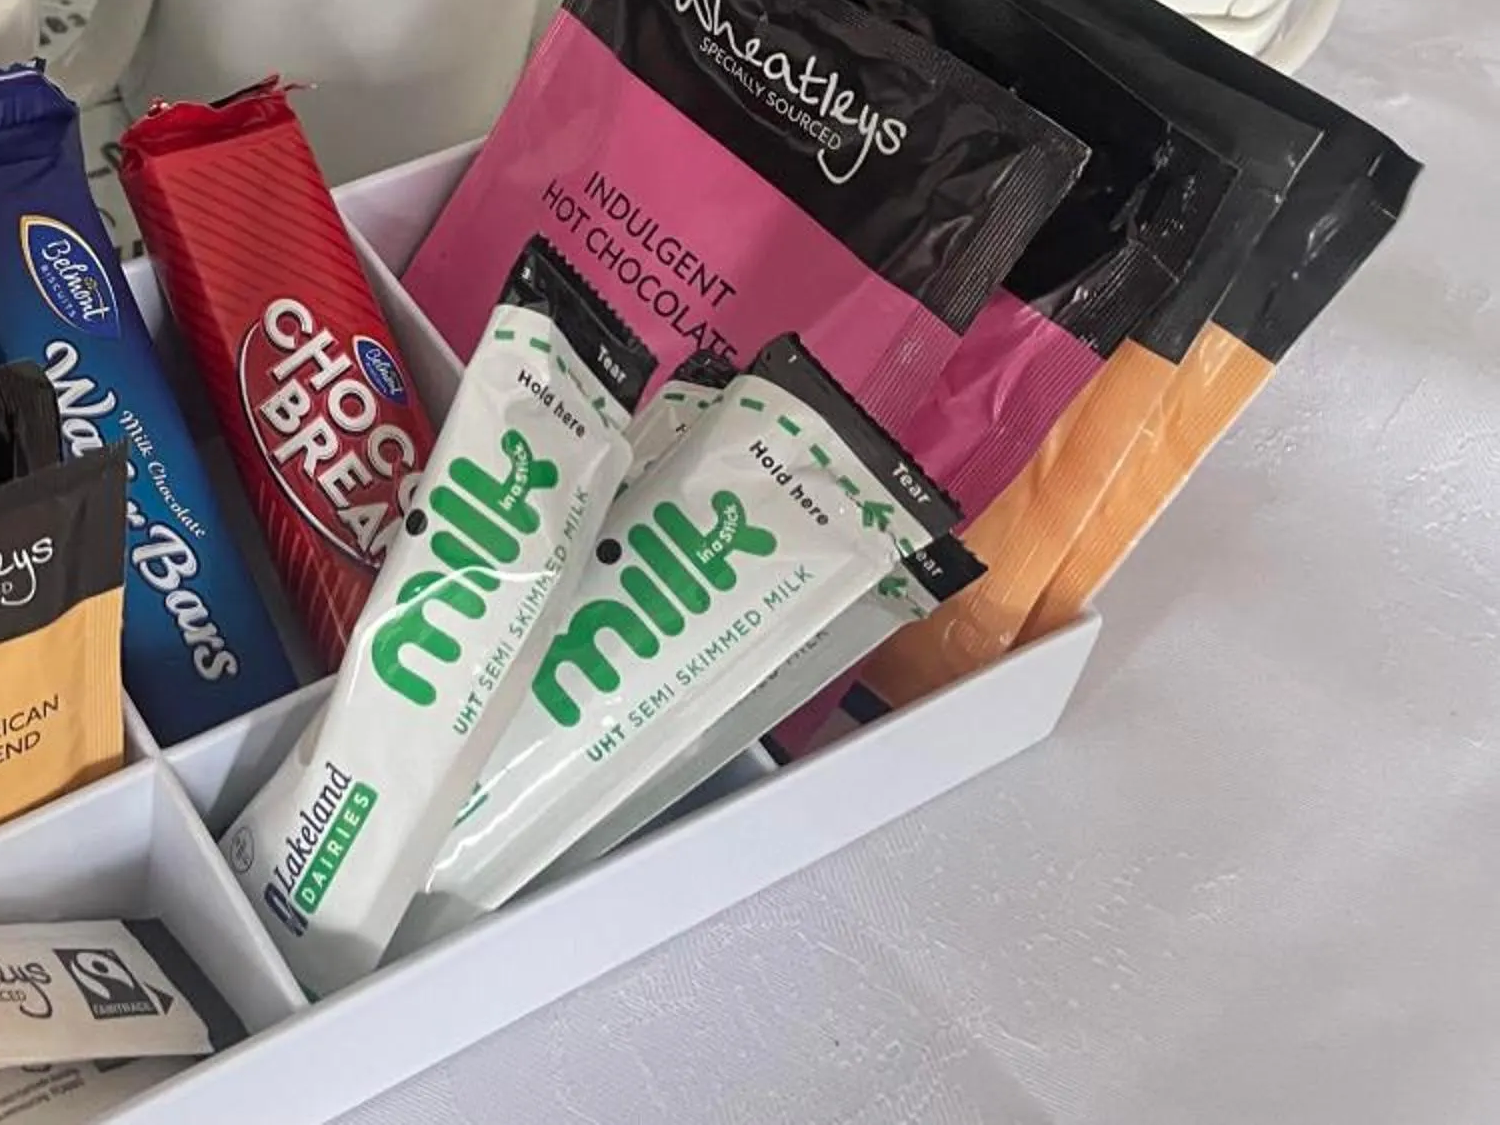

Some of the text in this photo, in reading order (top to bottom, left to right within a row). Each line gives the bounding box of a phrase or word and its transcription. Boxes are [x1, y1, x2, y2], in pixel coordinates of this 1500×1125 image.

[700, 36, 842, 151] SPECIALLY SOURCED
[541, 179, 590, 233] HOT
[584, 171, 736, 307] INDULGENT
[41, 237, 111, 321] Belmont
[518, 369, 586, 438] Hold here
[597, 343, 627, 384] Tear
[119, 410, 207, 540] Milk Chocolate
[749, 440, 829, 526] Hold here
[891, 462, 932, 506] Tear
[133, 524, 239, 681] Bars
[371, 428, 560, 707] milk
[453, 488, 590, 736] UHT SEMI SKIMMED MILK
[531, 489, 778, 728] milk
[915, 550, 944, 578] ear
[586, 725, 627, 763] UHT
[628, 685, 675, 728] SEMI
[675, 607, 763, 687] SKIMMED
[763, 564, 815, 613] MILK
[273, 760, 353, 894] Lakeland
[301, 792, 371, 905] DAIRIES
